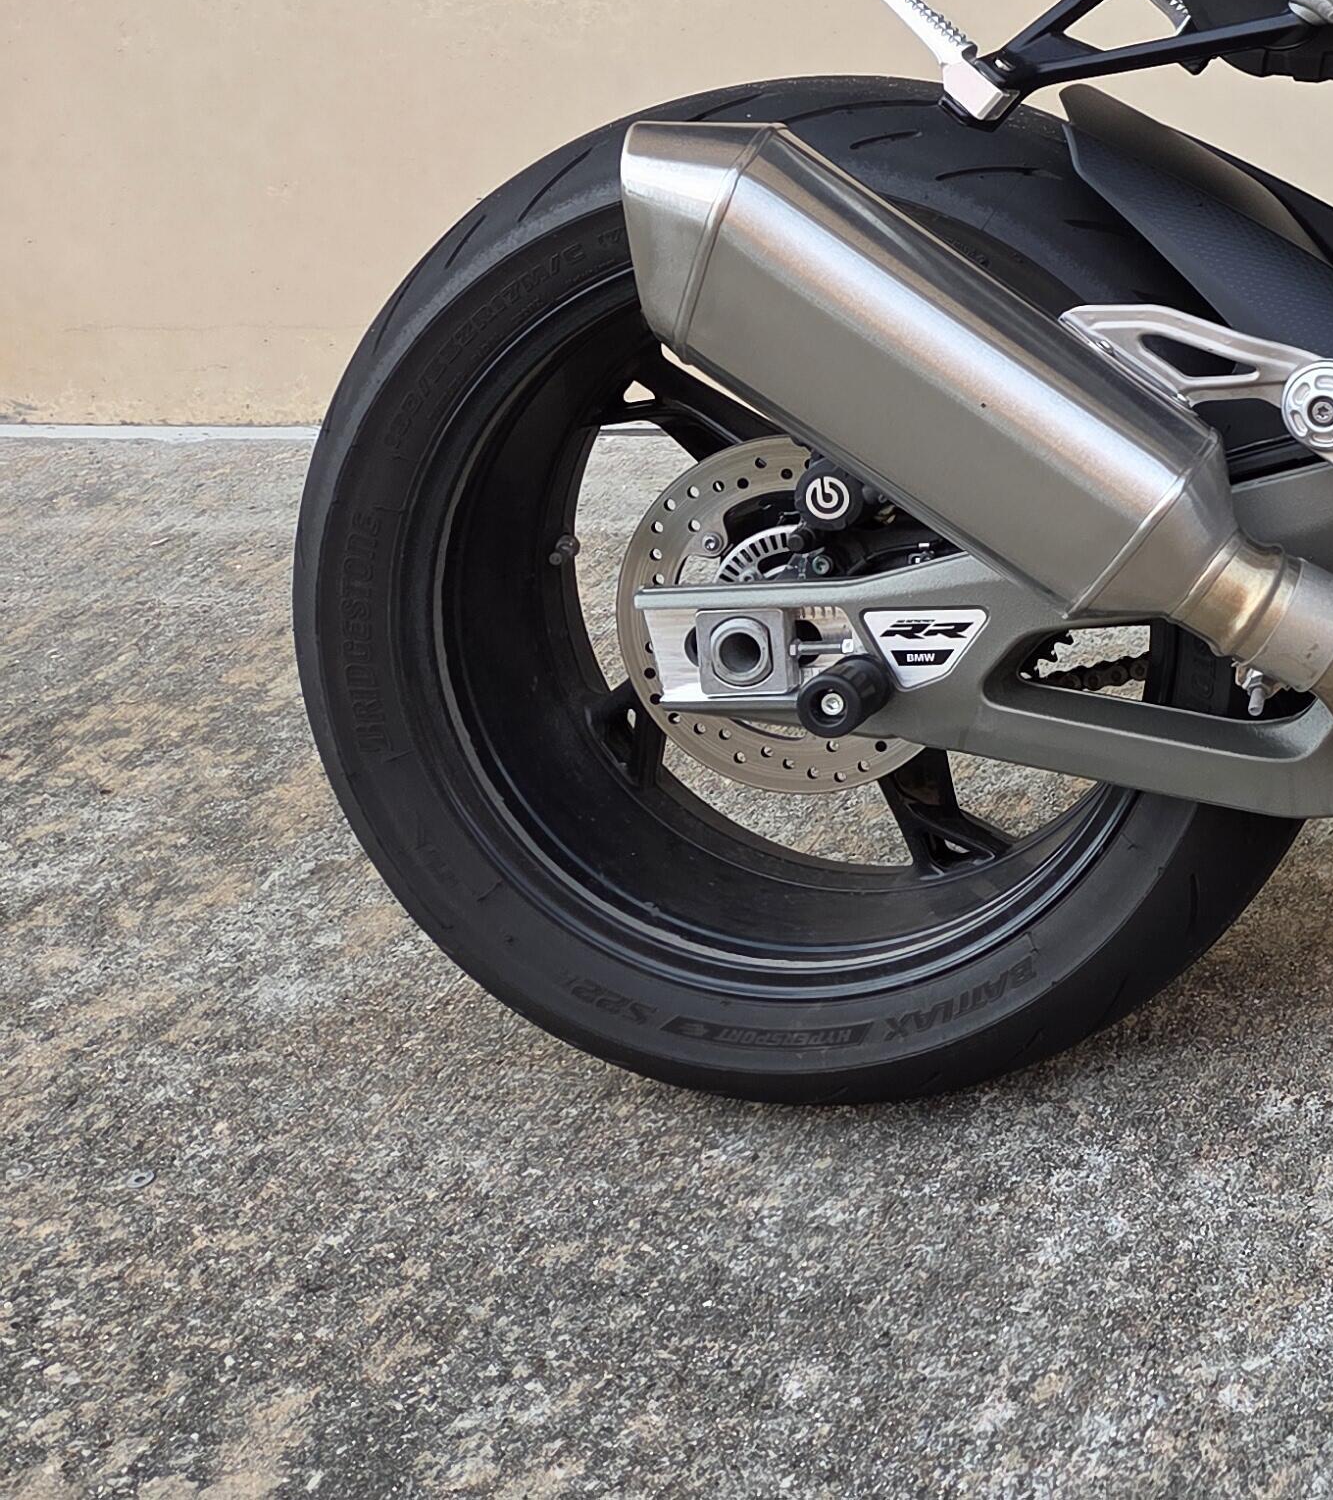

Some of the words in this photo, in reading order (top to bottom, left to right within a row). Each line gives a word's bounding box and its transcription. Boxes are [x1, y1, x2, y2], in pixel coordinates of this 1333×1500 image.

[880, 621, 975, 640] RR
[906, 653, 936, 663] BMW
[883, 954, 1038, 1042] BATTLAX
[717, 1027, 853, 1047] HYPERSPORT
